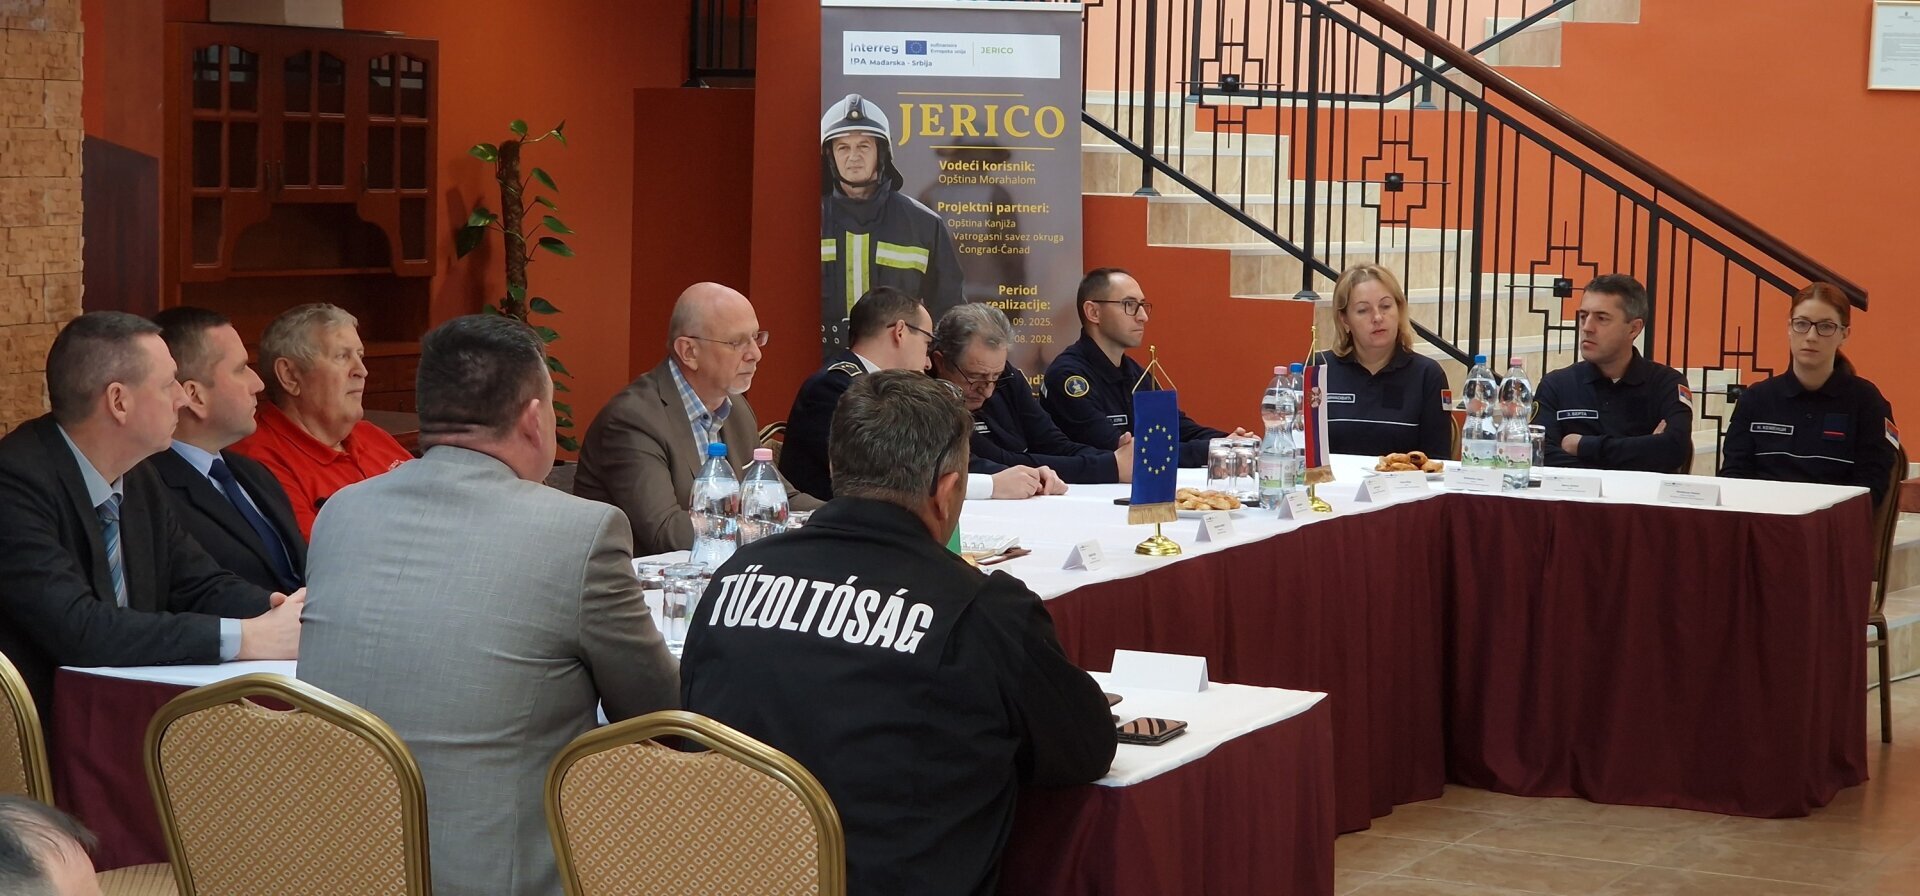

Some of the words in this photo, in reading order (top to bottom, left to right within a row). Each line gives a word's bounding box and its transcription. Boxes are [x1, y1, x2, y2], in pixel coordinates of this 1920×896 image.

[850, 43, 899, 55] Interreg
[850, 57, 867, 65] IPA
[911, 60, 933, 68] Srbija
[898, 103, 1065, 146] JERICO
[939, 160, 979, 171] Vodeći
[982, 161, 1036, 172] korisnik:
[938, 174, 977, 185] Opština
[979, 175, 1036, 184] Morahalom
[937, 202, 993, 214] Projektni
[996, 203, 1050, 215] partneri:
[947, 219, 982, 229] Opština
[984, 219, 1016, 230] Kanjiža
[953, 232, 1002, 242] Vatrogasni
[1033, 233, 1064, 244] okruga
[958, 243, 1030, 256] Čongrad-Čanad
[998, 284, 1038, 296] Period
[1012, 317, 1027, 326] 09.
[1029, 317, 1053, 327] 2025.
[1014, 334, 1028, 344] 08.
[1030, 335, 1055, 344] 2028.
[709, 564, 934, 654] TŰZOLTÓSÁG
